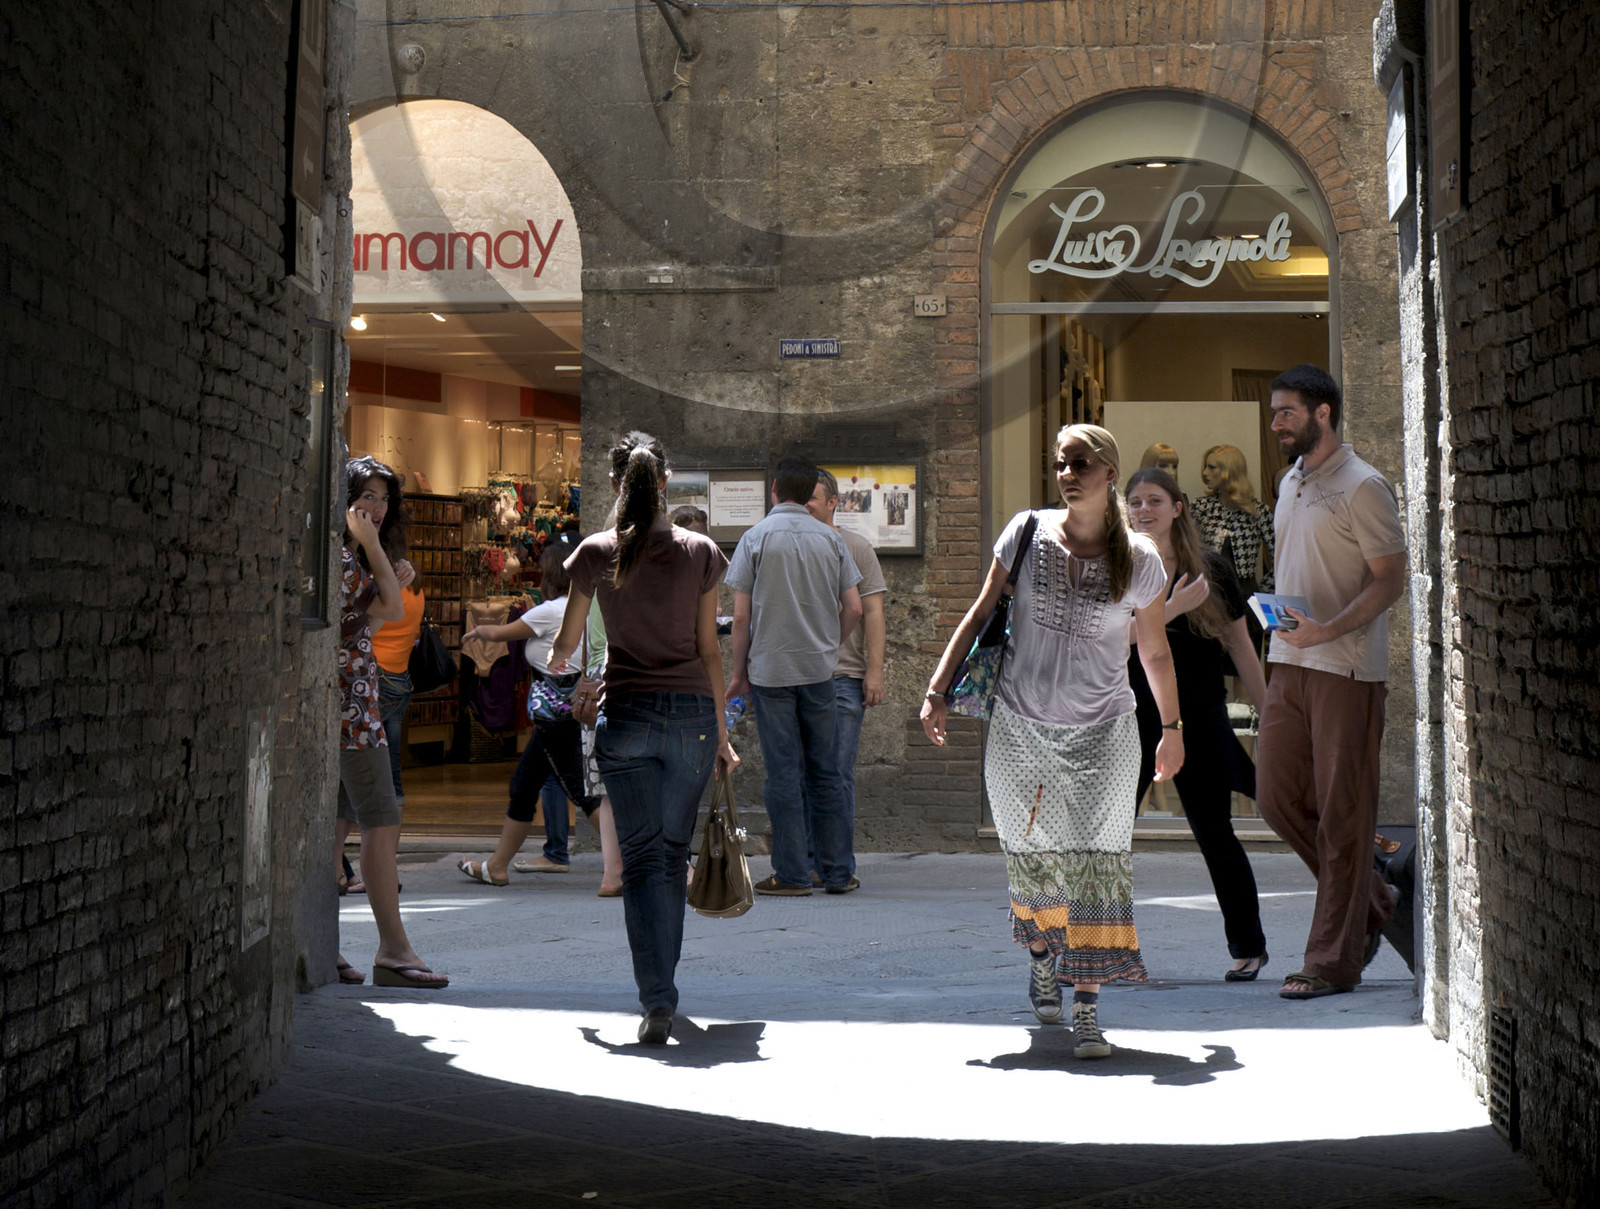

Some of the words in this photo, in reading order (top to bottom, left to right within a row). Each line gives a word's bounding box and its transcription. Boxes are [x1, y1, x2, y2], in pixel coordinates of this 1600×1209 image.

[353, 218, 564, 278] mamay
[1028, 189, 1140, 279] Luisa
[1124, 190, 1293, 288] Spagnoli
[921, 298, 940, 314] 65
